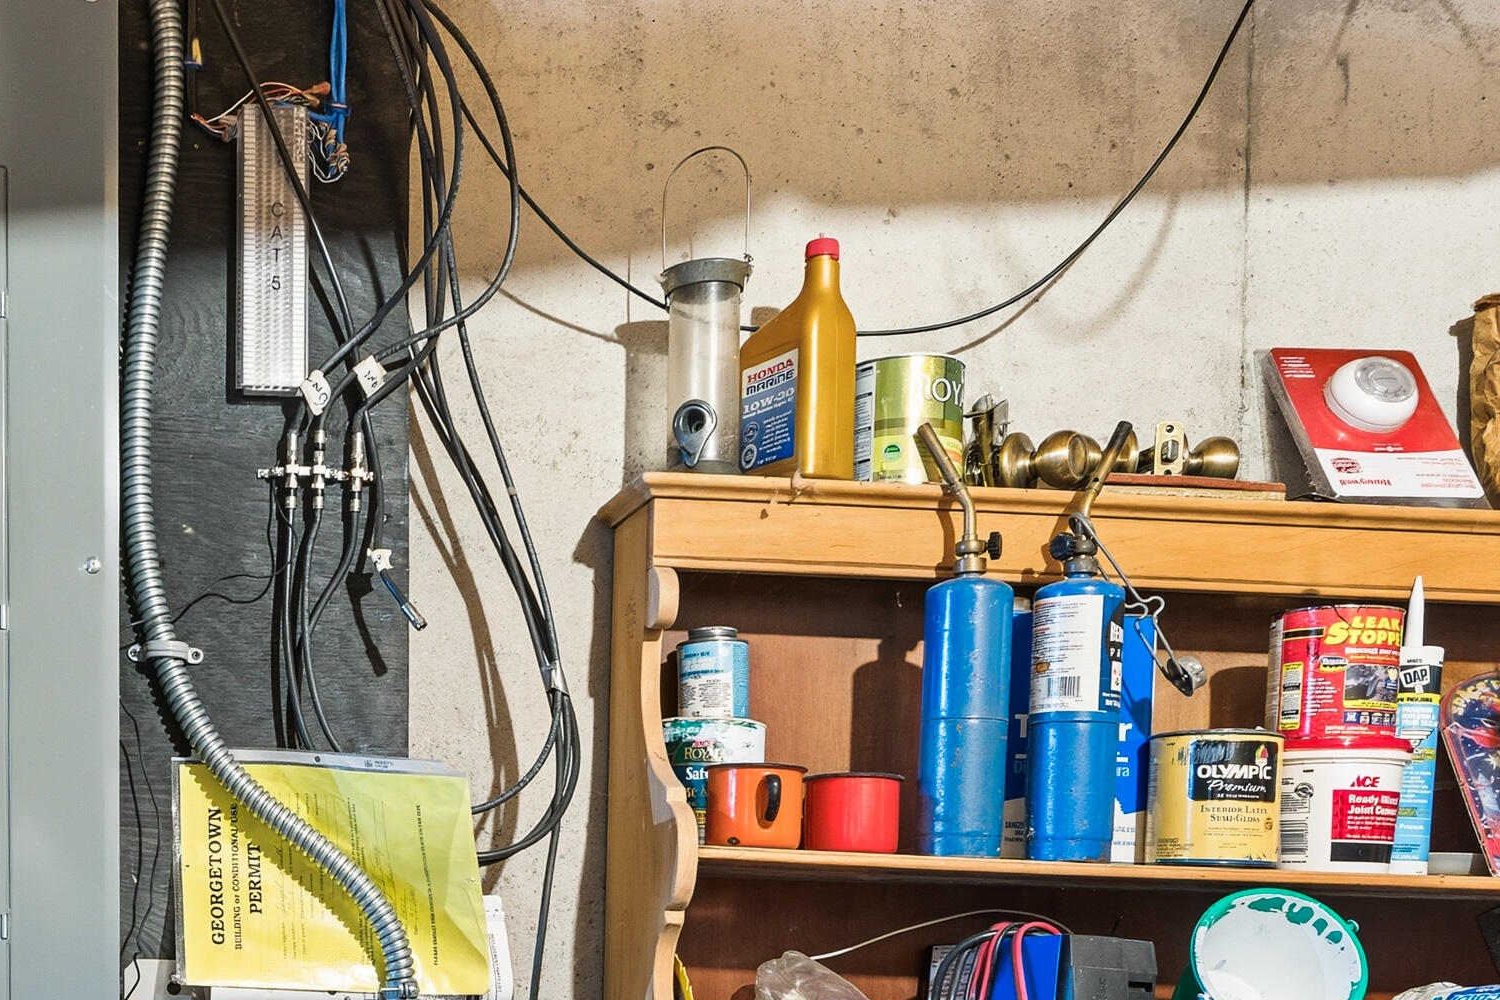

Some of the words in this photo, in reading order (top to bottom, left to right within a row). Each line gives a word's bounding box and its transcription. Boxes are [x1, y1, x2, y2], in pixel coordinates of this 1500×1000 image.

[747, 358, 794, 383] HONDA
[746, 369, 794, 395] MARINE
[1351, 616, 1400, 631] LEAK
[1403, 669, 1428, 685] DAP
[1196, 763, 1272, 780] OLYMPIC
[1206, 779, 1267, 793] Premium
[1350, 775, 1380, 788] ACE
[1348, 794, 1379, 806] Ready
[1348, 805, 1374, 815] Joint
[230, 825, 242, 893] CONDITIONAL
[207, 807, 226, 946] GEORGETOWN
[246, 842, 264, 915] PERMIT
[234, 893, 241, 904] or
[231, 905, 243, 950] BUILDING
